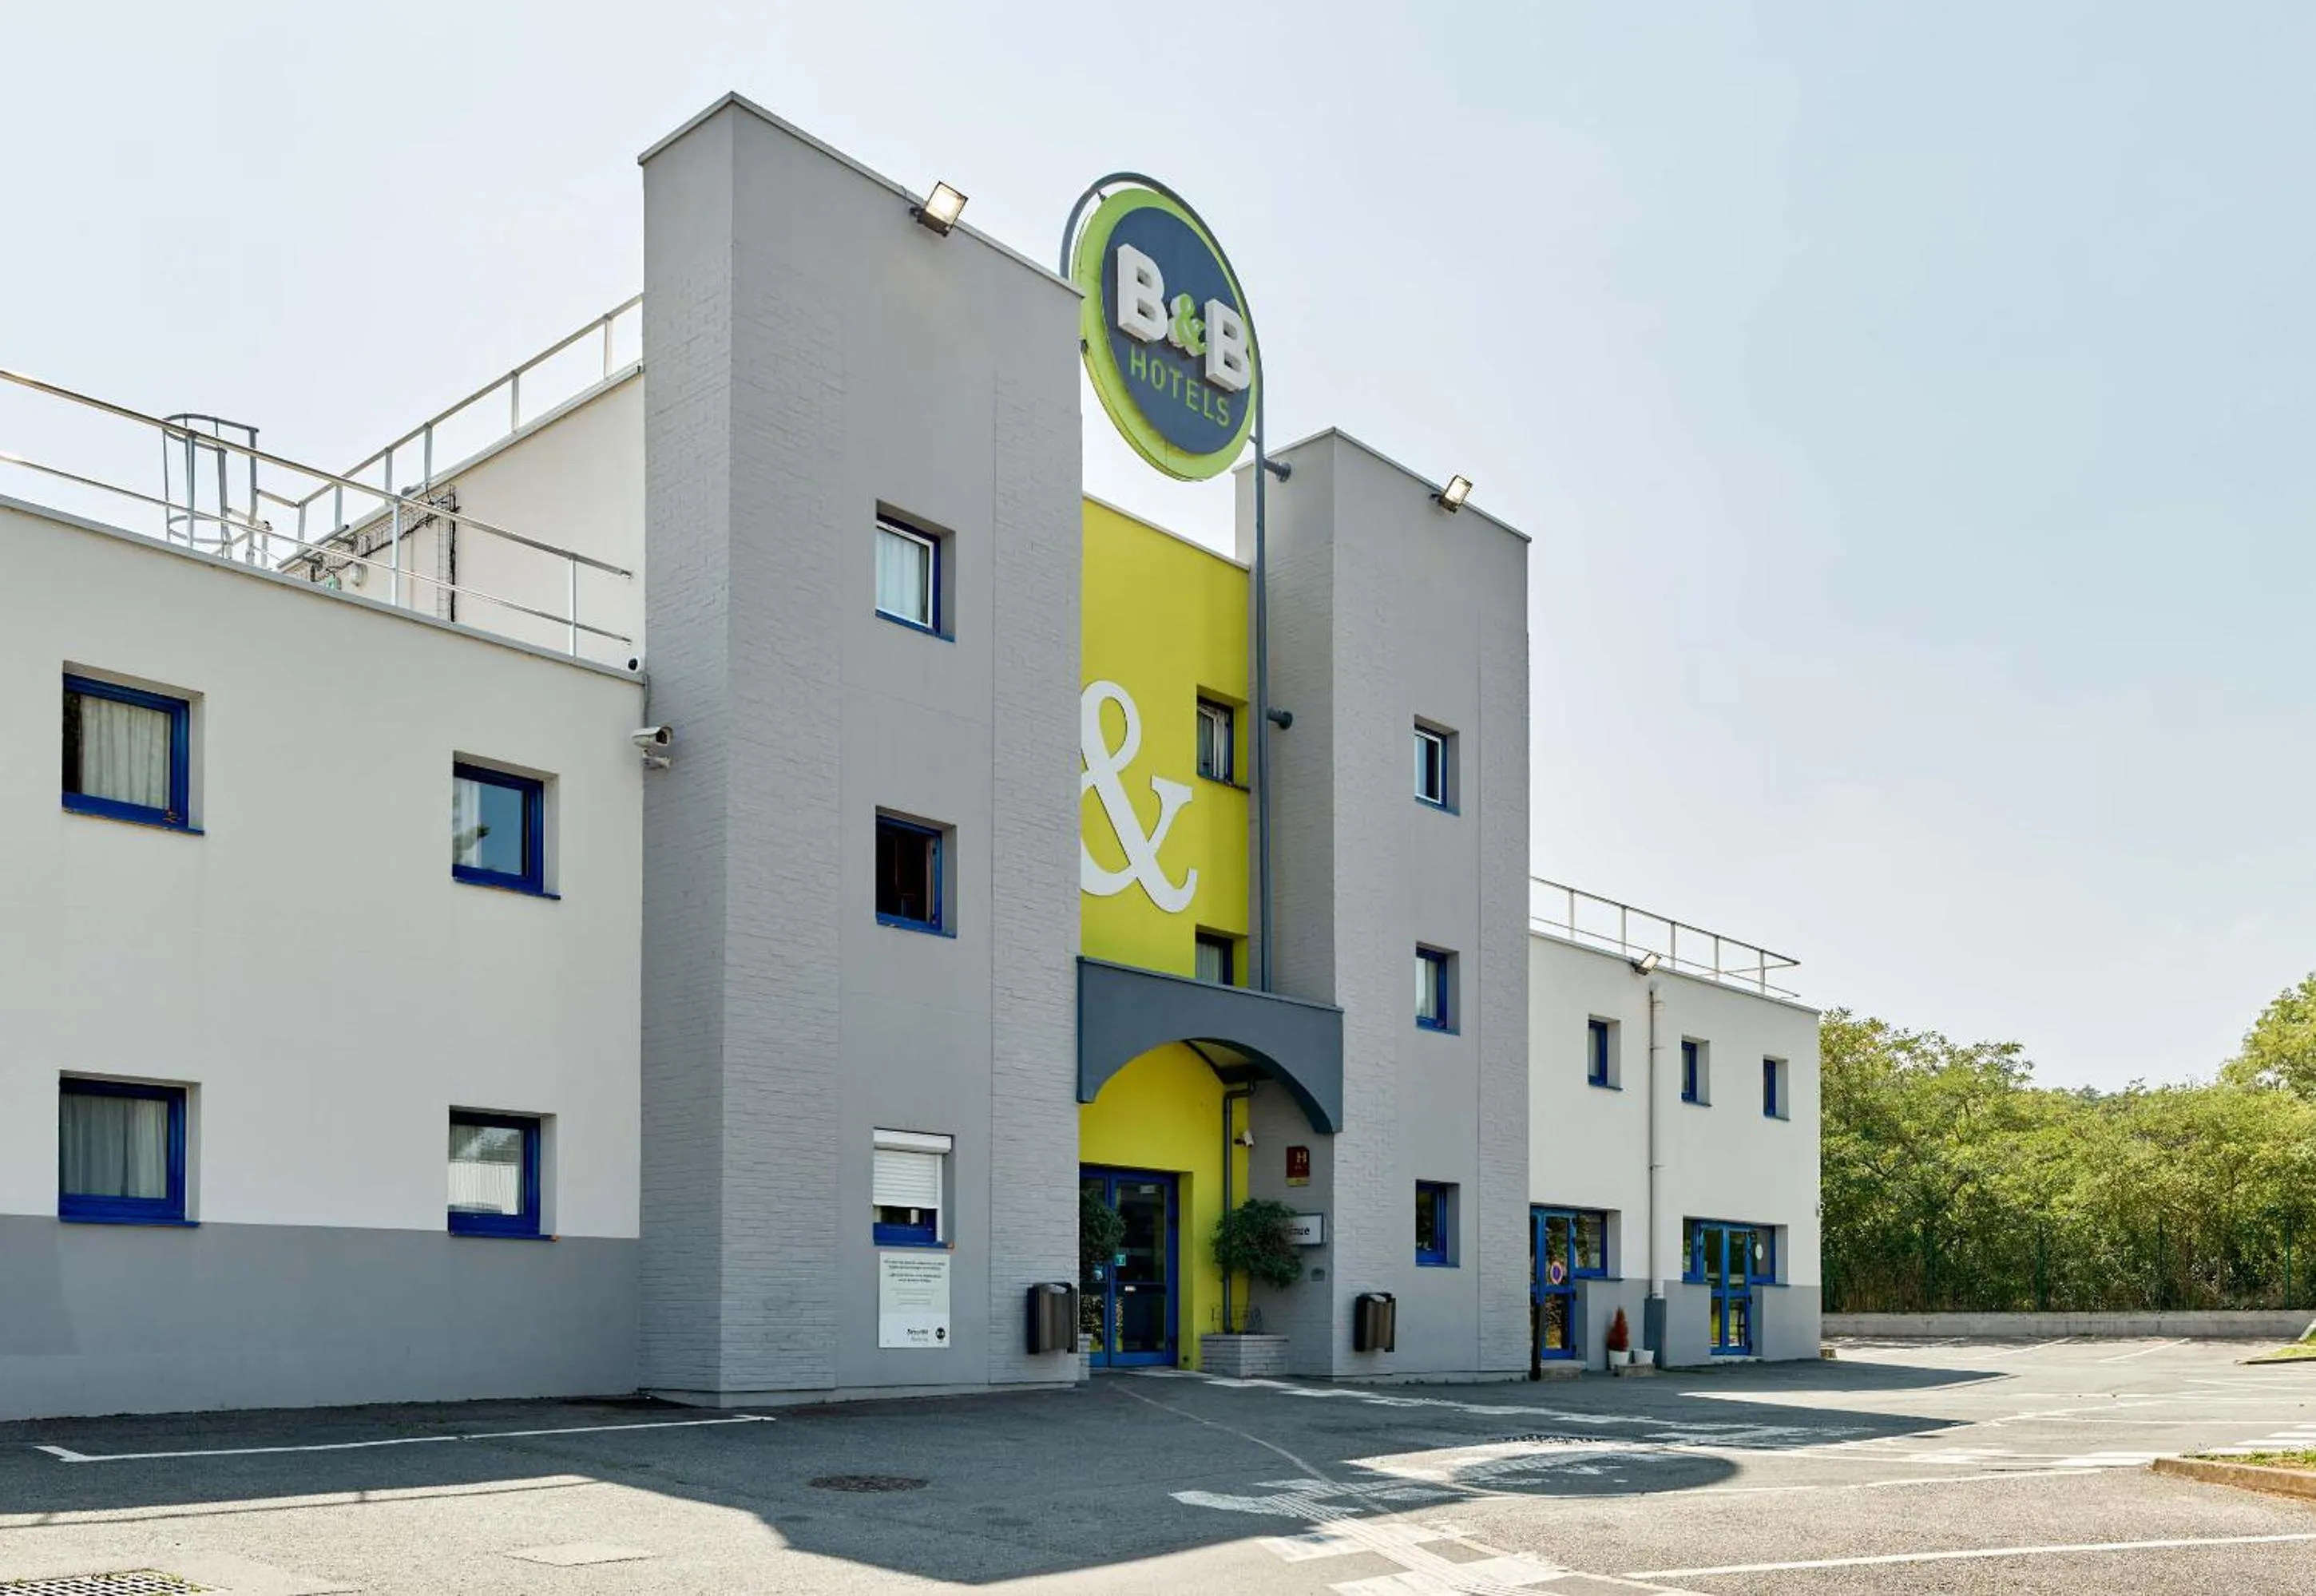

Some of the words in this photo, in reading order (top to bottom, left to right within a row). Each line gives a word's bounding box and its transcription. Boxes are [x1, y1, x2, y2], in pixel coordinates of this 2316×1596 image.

[1116, 243, 1251, 392] B&B
[1129, 343, 1231, 428] HOTELS
[1081, 680, 1198, 913] &
[1296, 1151, 1307, 1163] H
